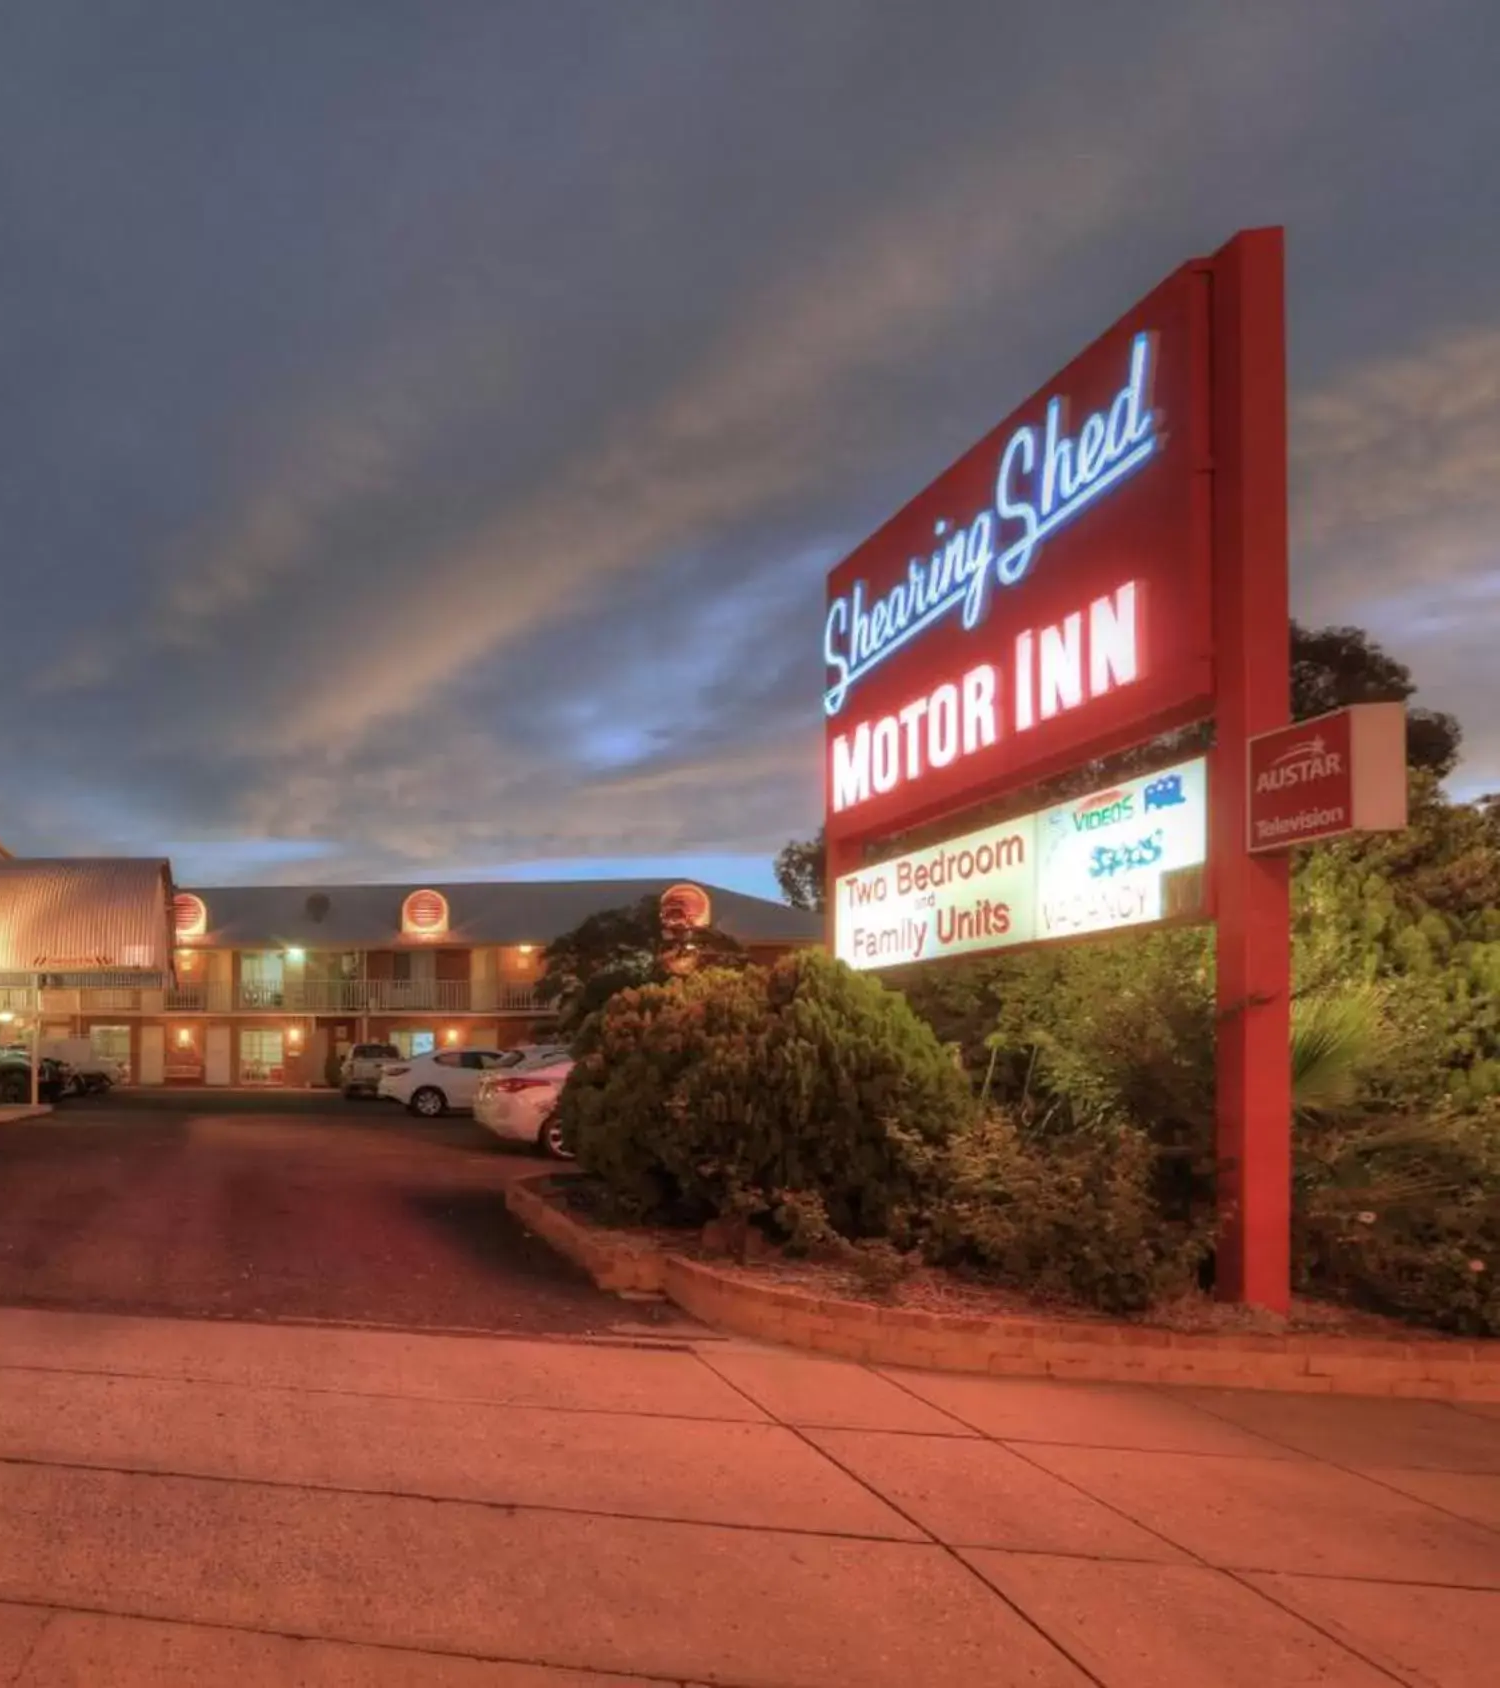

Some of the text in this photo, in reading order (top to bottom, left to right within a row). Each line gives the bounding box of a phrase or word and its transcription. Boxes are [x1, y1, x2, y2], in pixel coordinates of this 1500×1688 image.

[823, 331, 1157, 716] Shearing Shed
[832, 580, 1139, 813] MOTOR INN
[1256, 752, 1343, 793] AUSTAR
[1255, 807, 1344, 839] Television
[845, 834, 1025, 909] Two Bedroom
[854, 899, 1011, 957] Family Units
